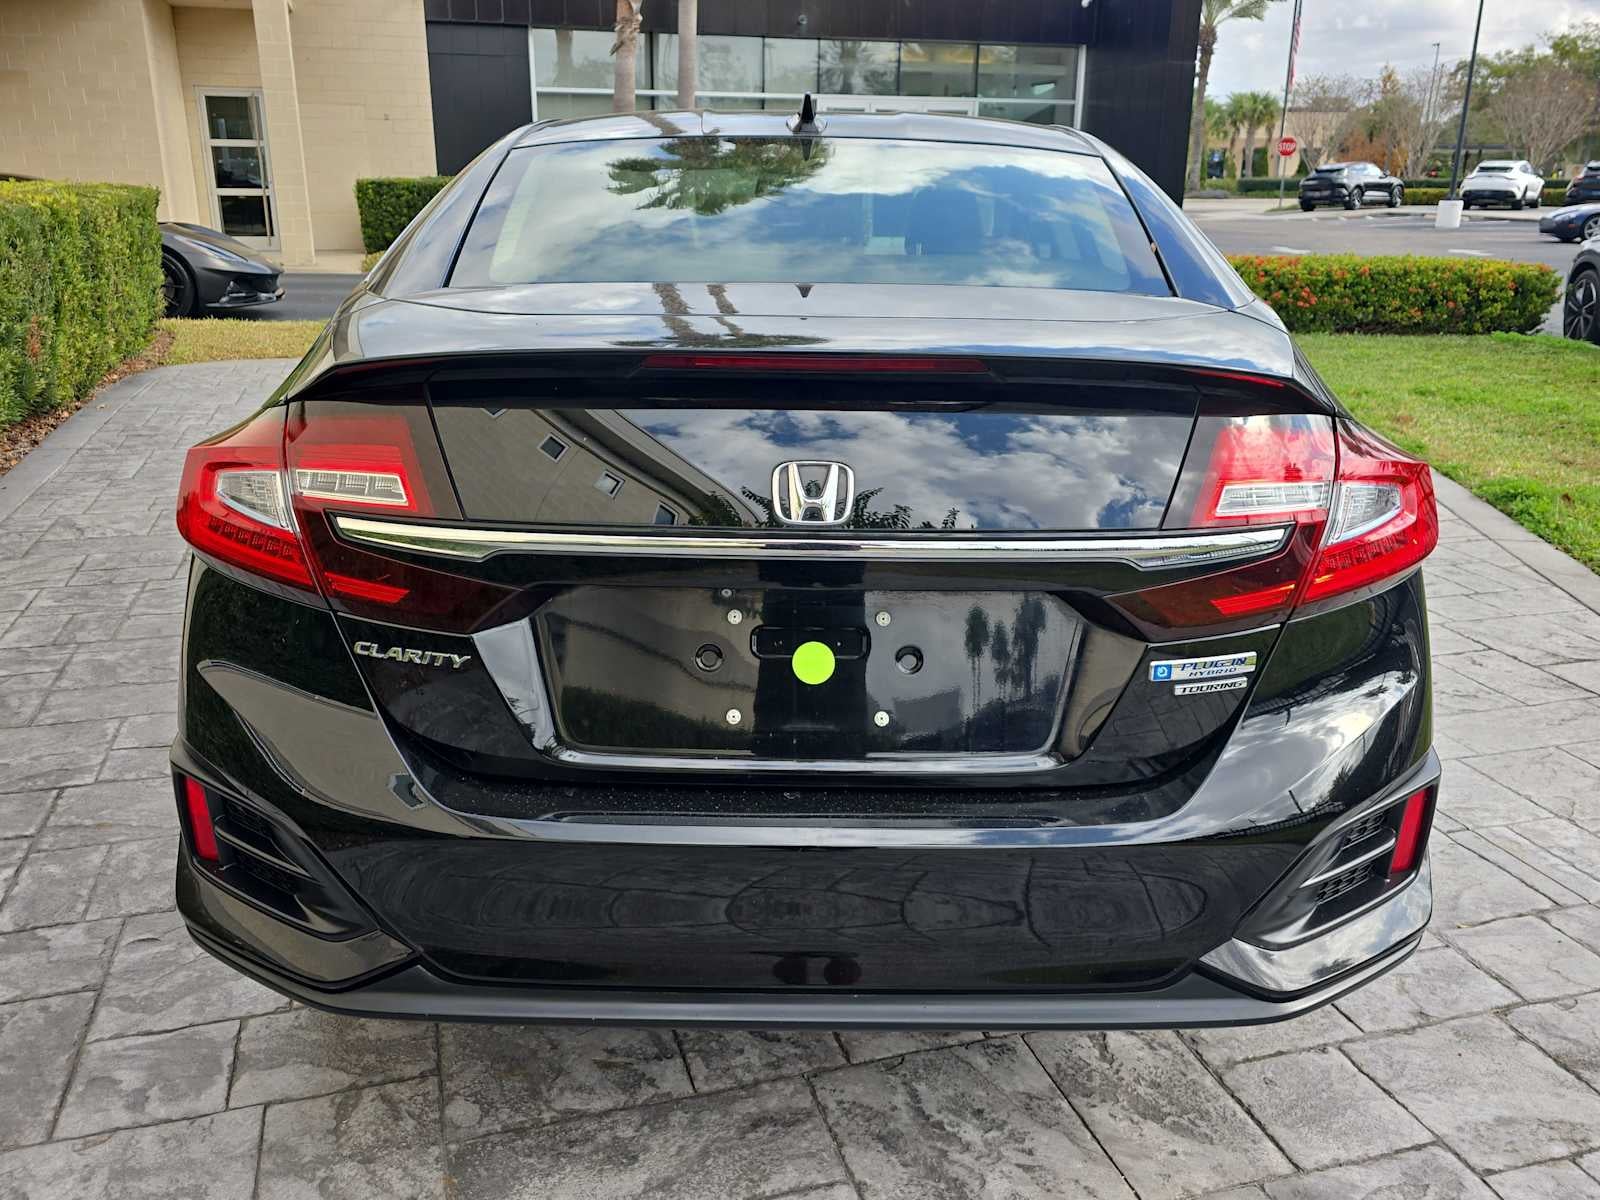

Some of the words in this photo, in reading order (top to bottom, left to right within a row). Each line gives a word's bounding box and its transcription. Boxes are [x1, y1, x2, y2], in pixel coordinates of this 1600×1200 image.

[1279, 142, 1295, 150] STOP
[354, 641, 471, 669] CLARITY
[1181, 657, 1248, 671] PLUG-IN
[1188, 667, 1237, 677] HYBRID
[1181, 682, 1243, 693] TOURING
